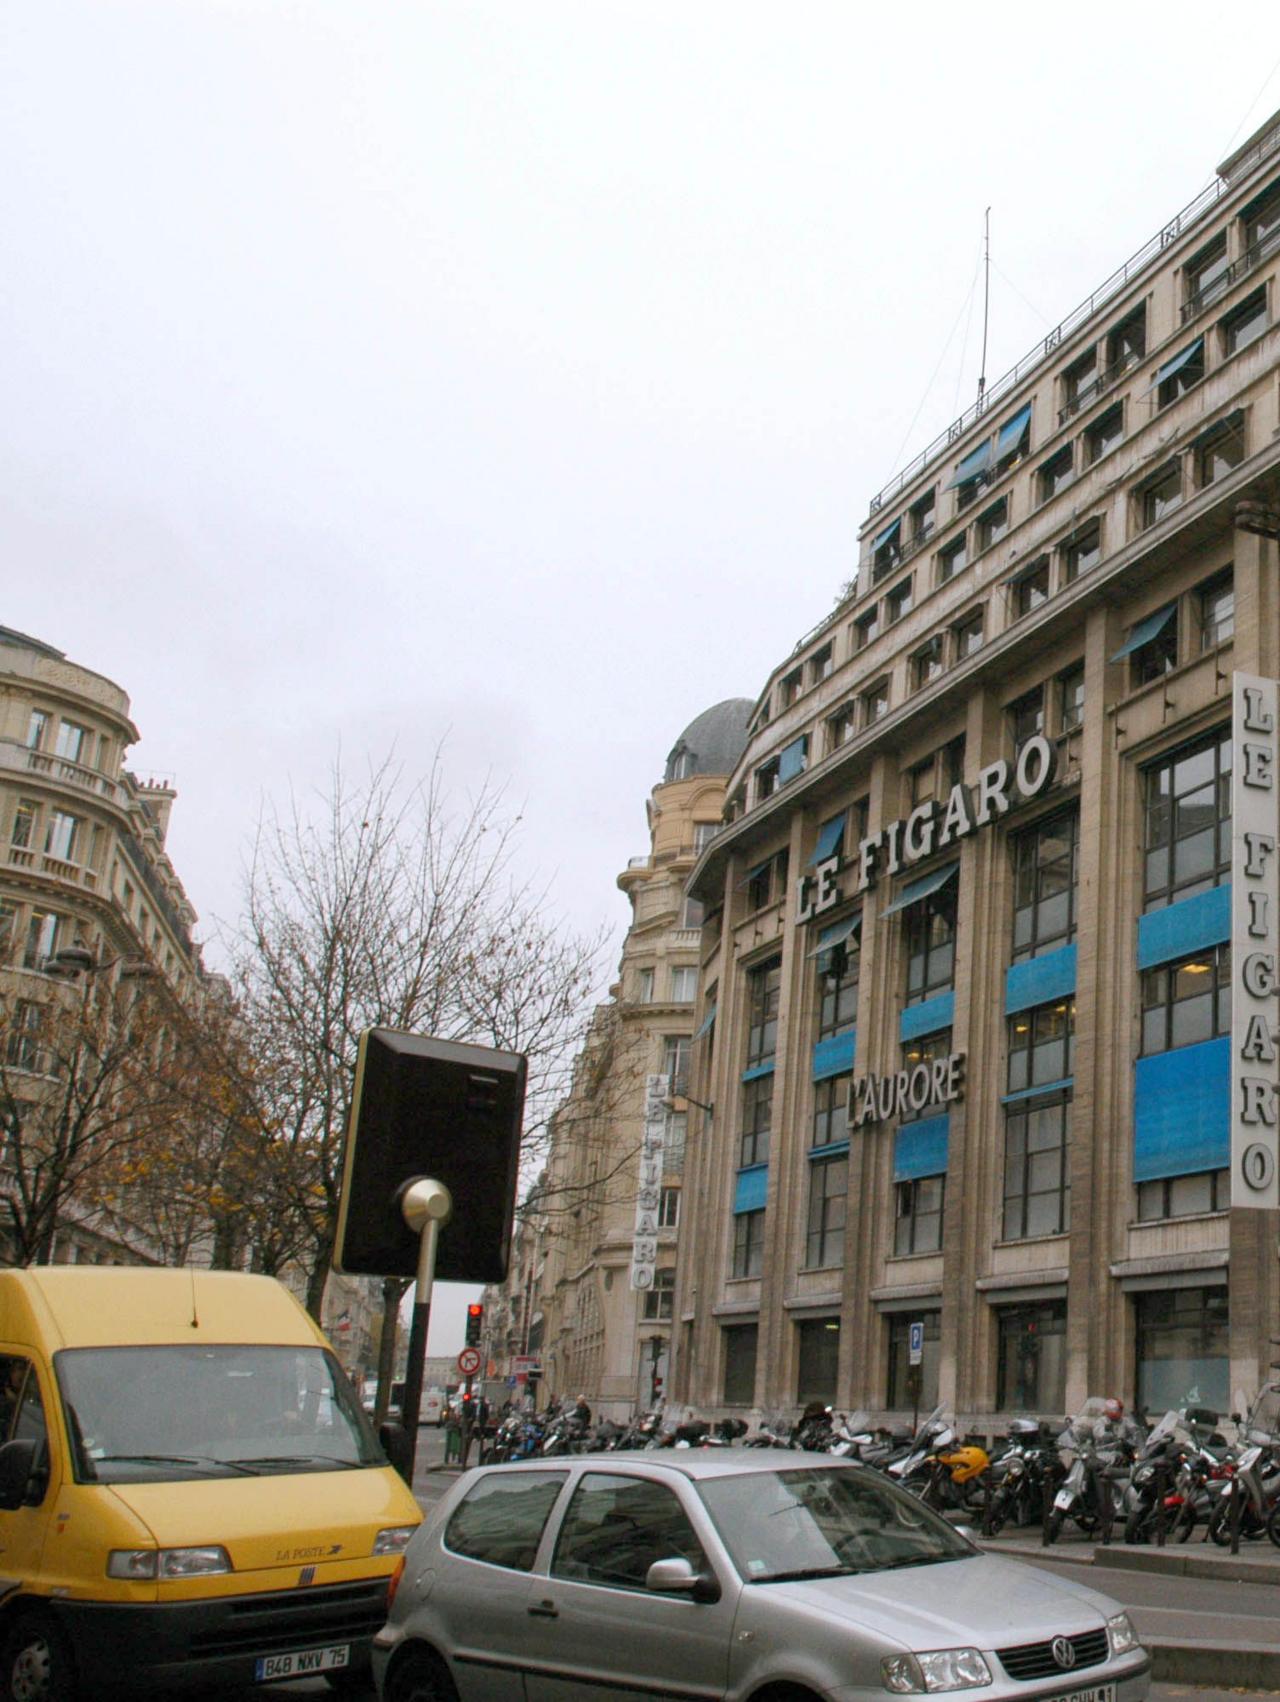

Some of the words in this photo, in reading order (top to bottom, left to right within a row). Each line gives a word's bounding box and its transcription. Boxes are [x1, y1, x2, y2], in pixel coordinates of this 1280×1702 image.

[1243, 688, 1273, 789] LE
[795, 856, 844, 926] LE
[859, 735, 1057, 892] FIGARO
[1241, 832, 1276, 1190] FIGARO
[845, 1052, 965, 1130] L'AURORE
[276, 1550, 289, 1560] LA
[293, 1547, 325, 1559] POSTE
[298, 1651, 323, 1670] NXV
[329, 1648, 346, 1665] 75
